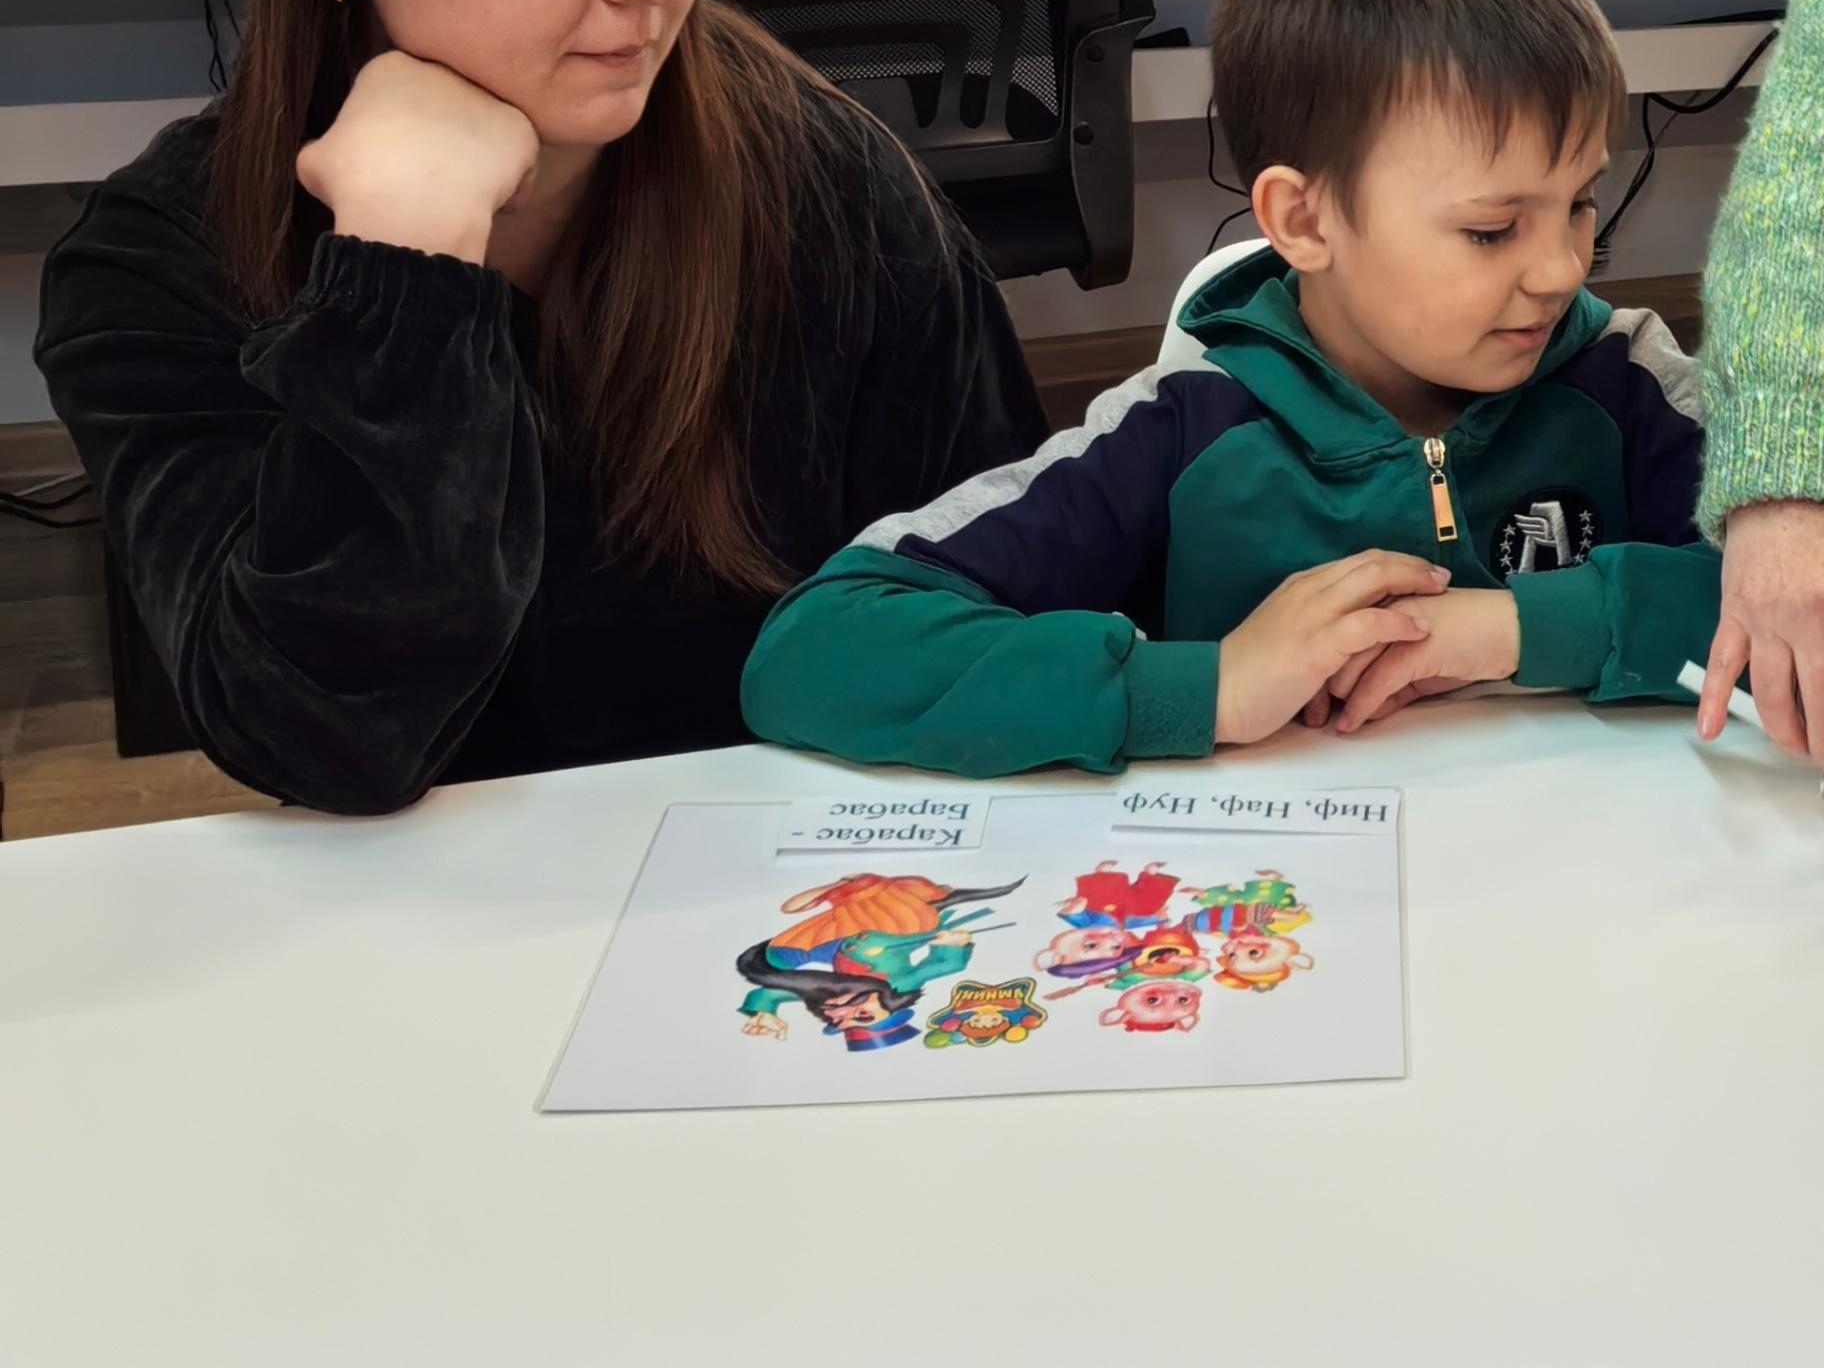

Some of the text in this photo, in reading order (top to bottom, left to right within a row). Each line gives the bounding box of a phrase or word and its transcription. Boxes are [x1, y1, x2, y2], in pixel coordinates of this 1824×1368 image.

[829, 799, 971, 820] Барабас
[1122, 792, 1389, 822] Ниф, Наф, Нуф
[816, 827, 963, 846] Карабас
